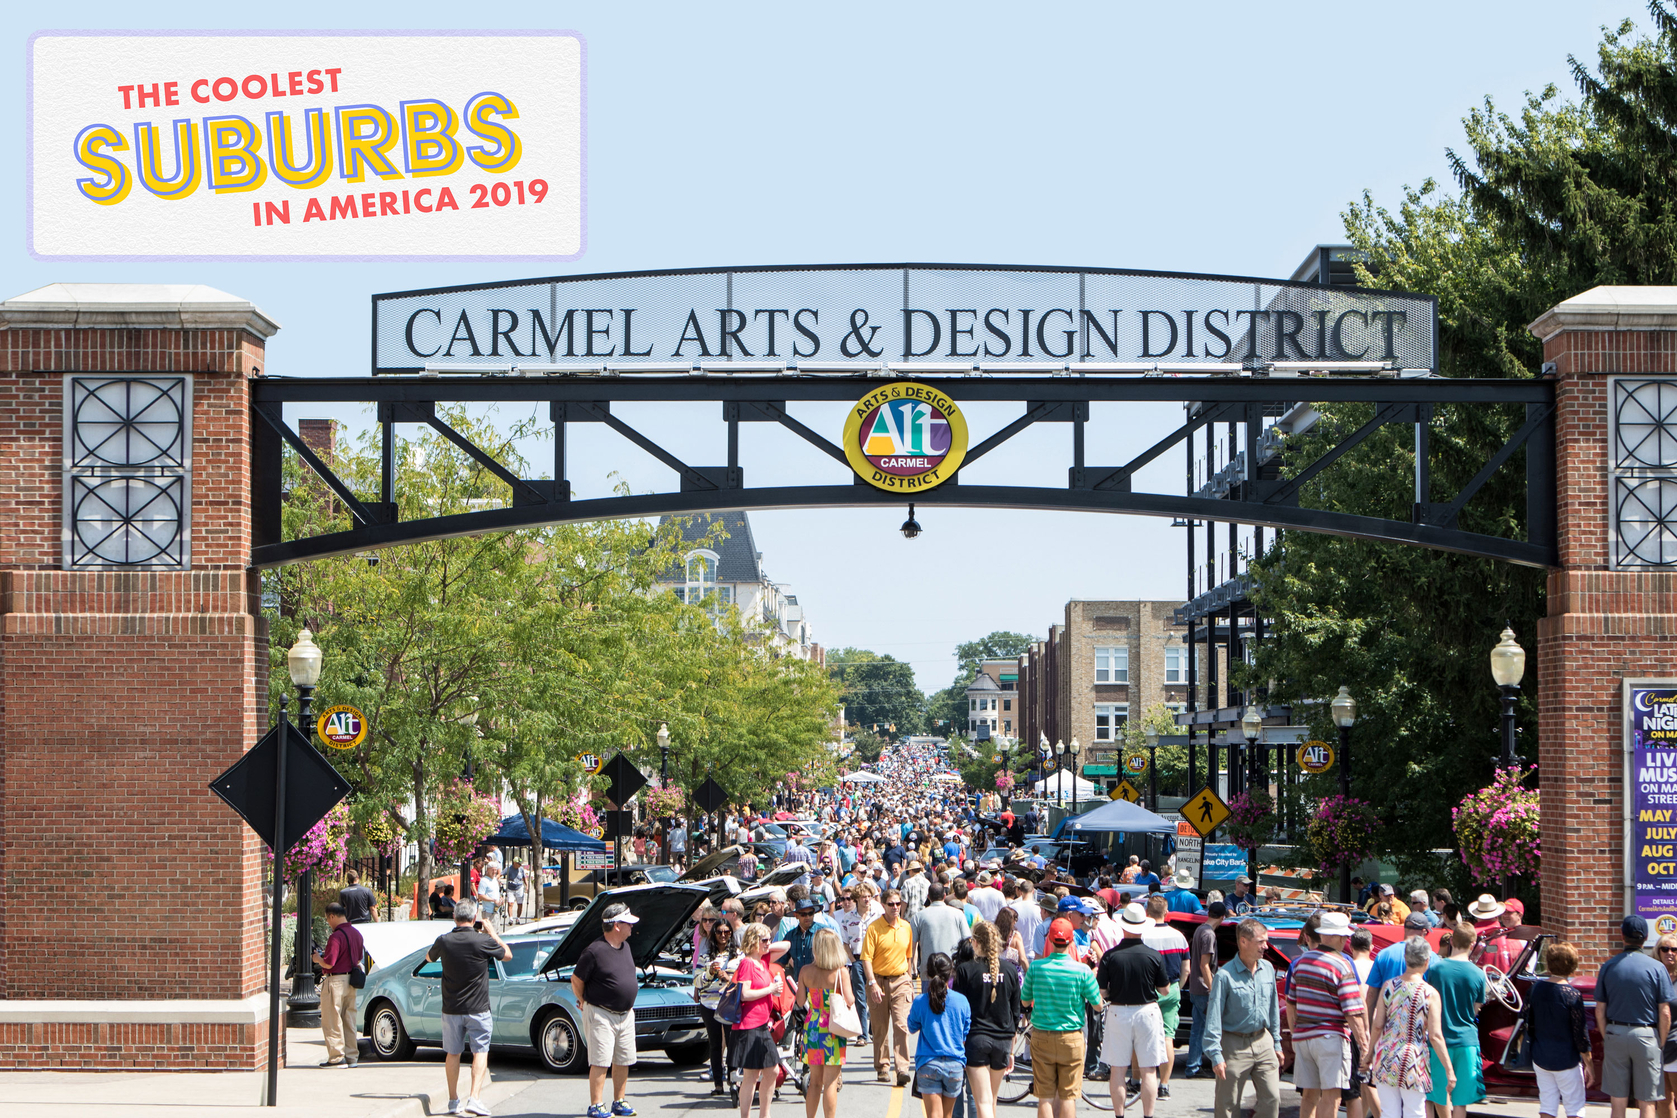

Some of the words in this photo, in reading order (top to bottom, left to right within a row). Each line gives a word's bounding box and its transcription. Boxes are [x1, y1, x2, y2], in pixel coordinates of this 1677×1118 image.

[404, 308, 653, 357] CARMEL
[671, 308, 820, 357] ARTS
[840, 308, 884, 357] &
[900, 308, 1122, 357] DESIGN
[1137, 309, 1407, 359] DISTRICT
[856, 390, 889, 419] ARTS
[891, 387, 901, 398] &
[905, 387, 955, 417] DESIGN
[861, 402, 949, 456] Art
[880, 458, 931, 467] CARMEL
[871, 469, 940, 488] DISTRICT
[322, 707, 336, 719] ARTS
[342, 706, 362, 719] DESIGN
[325, 712, 360, 735] Art
[1643, 716, 1677, 730] NIG
[328, 740, 357, 748] DISTRICT
[1303, 746, 1329, 763] Art
[1646, 752, 1677, 767] LIV
[1641, 784, 1658, 793] ON
[1639, 809, 1673, 822] MAY
[1180, 824, 1197, 834] DETO
[1645, 827, 1677, 840] JULY
[1179, 838, 1201, 847] NORTH
[1641, 845, 1673, 857] AUG
[1215, 858, 1229, 867] City
[1647, 862, 1676, 875] OCT
[982, 972, 1004, 982] SCTT
